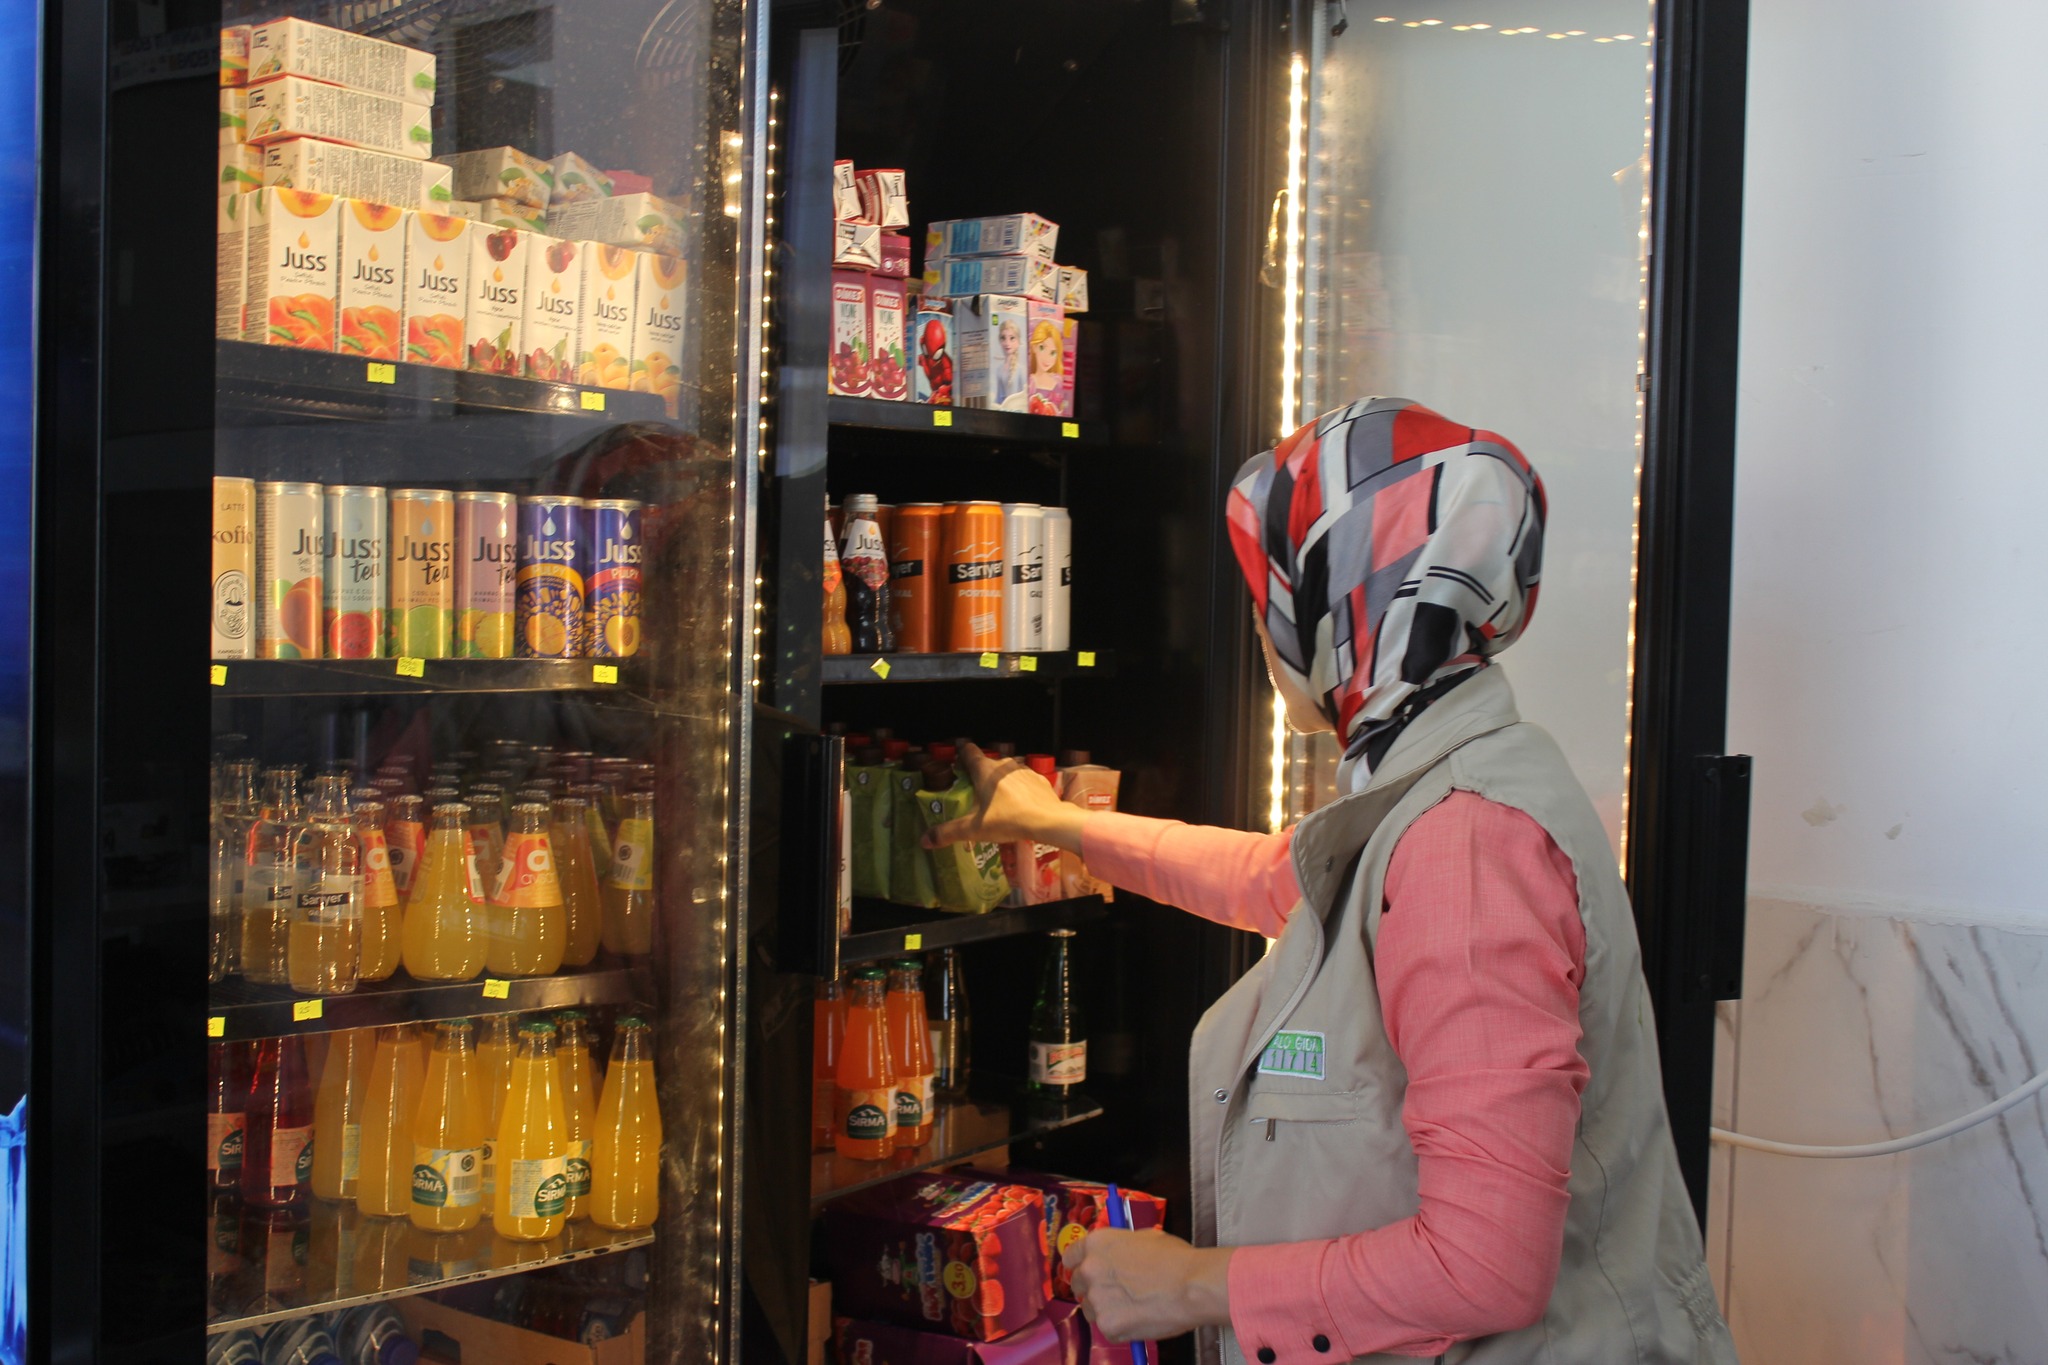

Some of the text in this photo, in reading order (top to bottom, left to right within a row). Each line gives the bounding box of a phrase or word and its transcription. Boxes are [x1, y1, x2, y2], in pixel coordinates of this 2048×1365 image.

[280, 246, 327, 272] Juss
[352, 259, 394, 285] Juss
[419, 268, 459, 294] Juss
[479, 279, 518, 304] Juss
[536, 290, 574, 316] Juss
[593, 297, 628, 322] Juss
[645, 307, 682, 331] Juss
[220, 503, 245, 512] LATTE
[325, 532, 382, 560] Juss
[397, 536, 450, 562] Juss
[473, 536, 517, 563] Juss
[522, 534, 576, 561] Juss
[600, 538, 642, 564] Juss
[350, 560, 381, 584] tea
[421, 562, 450, 585] tea
[611, 568, 639, 579] PULPY
